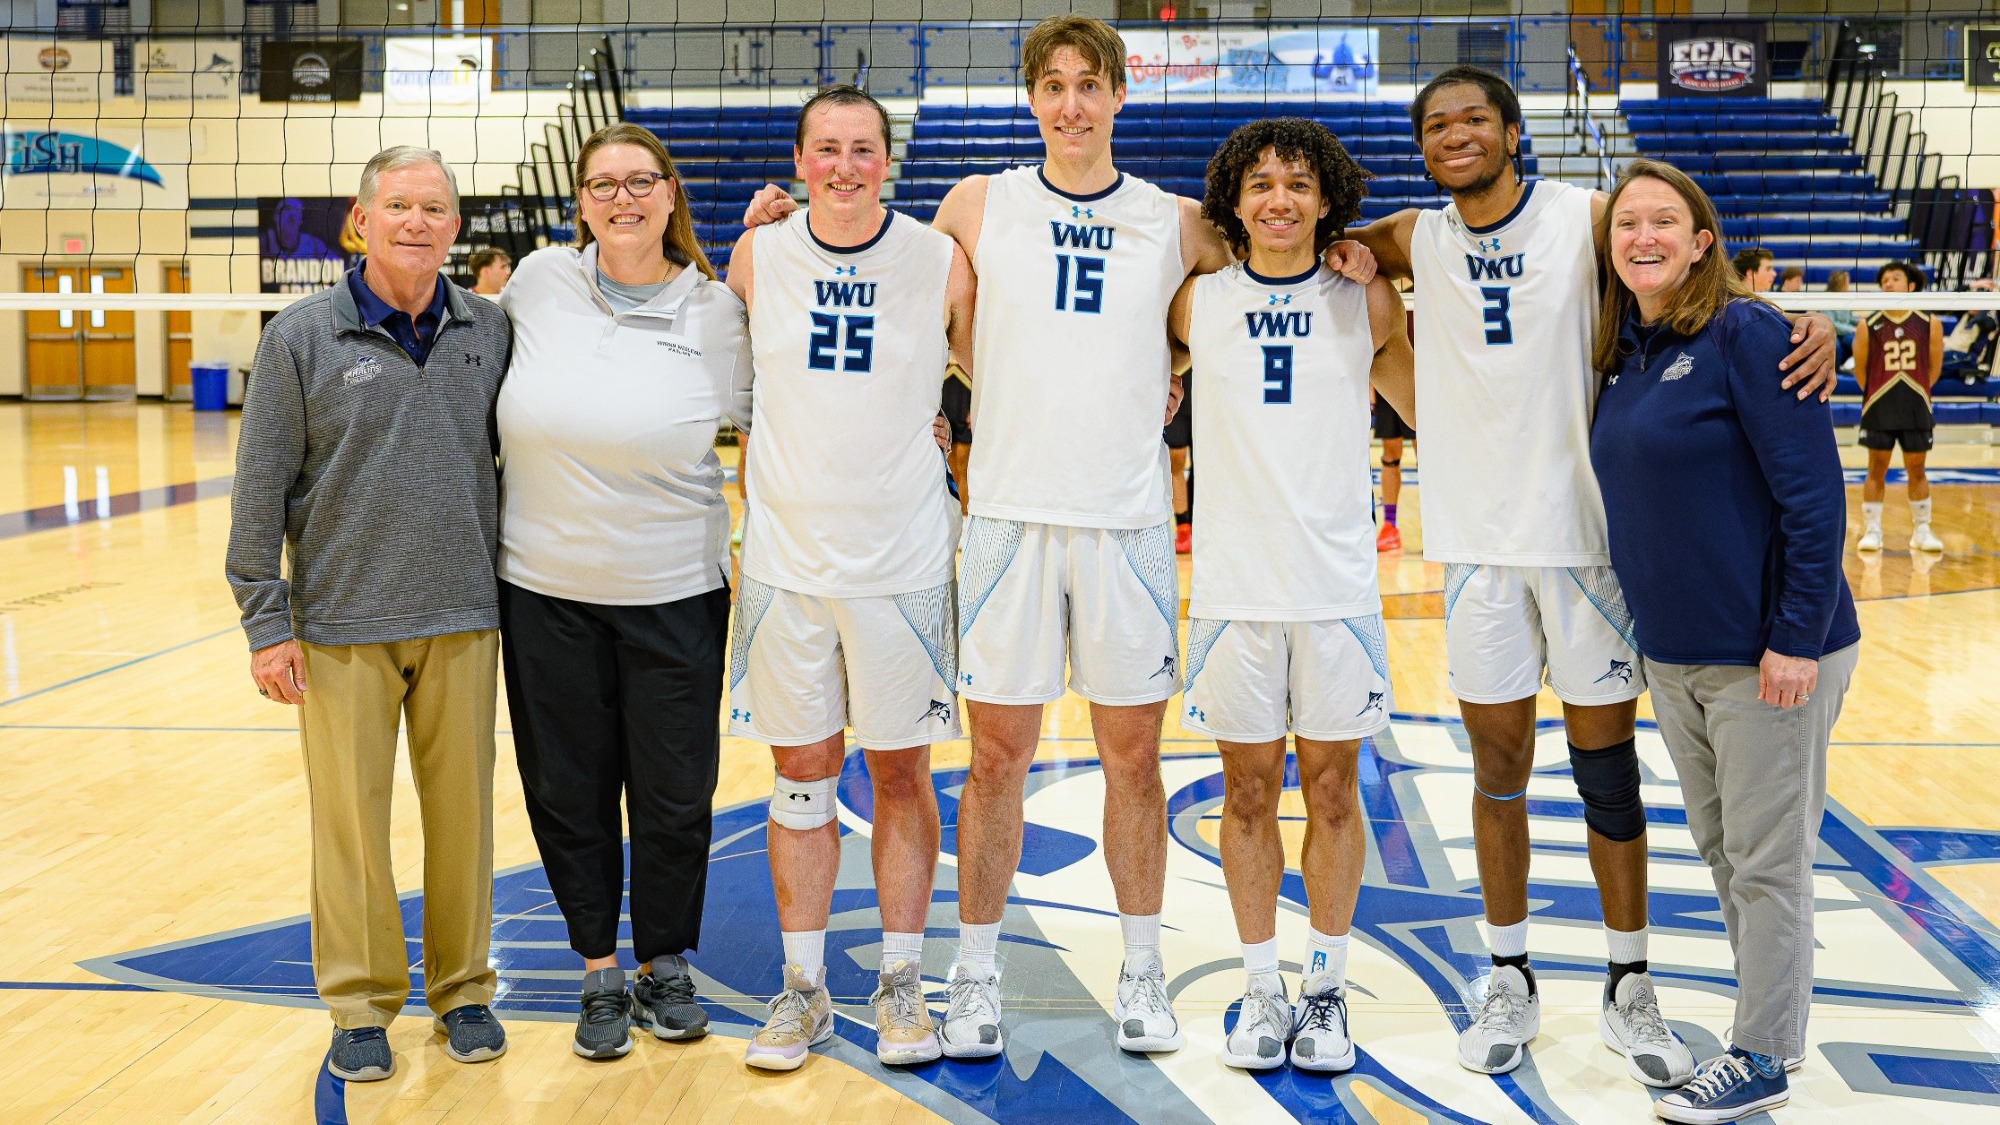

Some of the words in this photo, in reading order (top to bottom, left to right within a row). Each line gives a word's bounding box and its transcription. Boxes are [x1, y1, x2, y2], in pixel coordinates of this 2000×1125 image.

[1672, 41, 1752, 71] ECAC
[1049, 220, 1116, 251] VWU
[262, 258, 345, 284] BRANDON
[1464, 252, 1525, 281] VWU
[813, 279, 878, 308] VWU
[1055, 253, 1106, 314] 15
[1245, 310, 1313, 338] VWU
[1479, 286, 1513, 345] 3
[808, 310, 876, 373] 25
[1883, 339, 1917, 371] 22
[1260, 345, 1293, 404] 9
